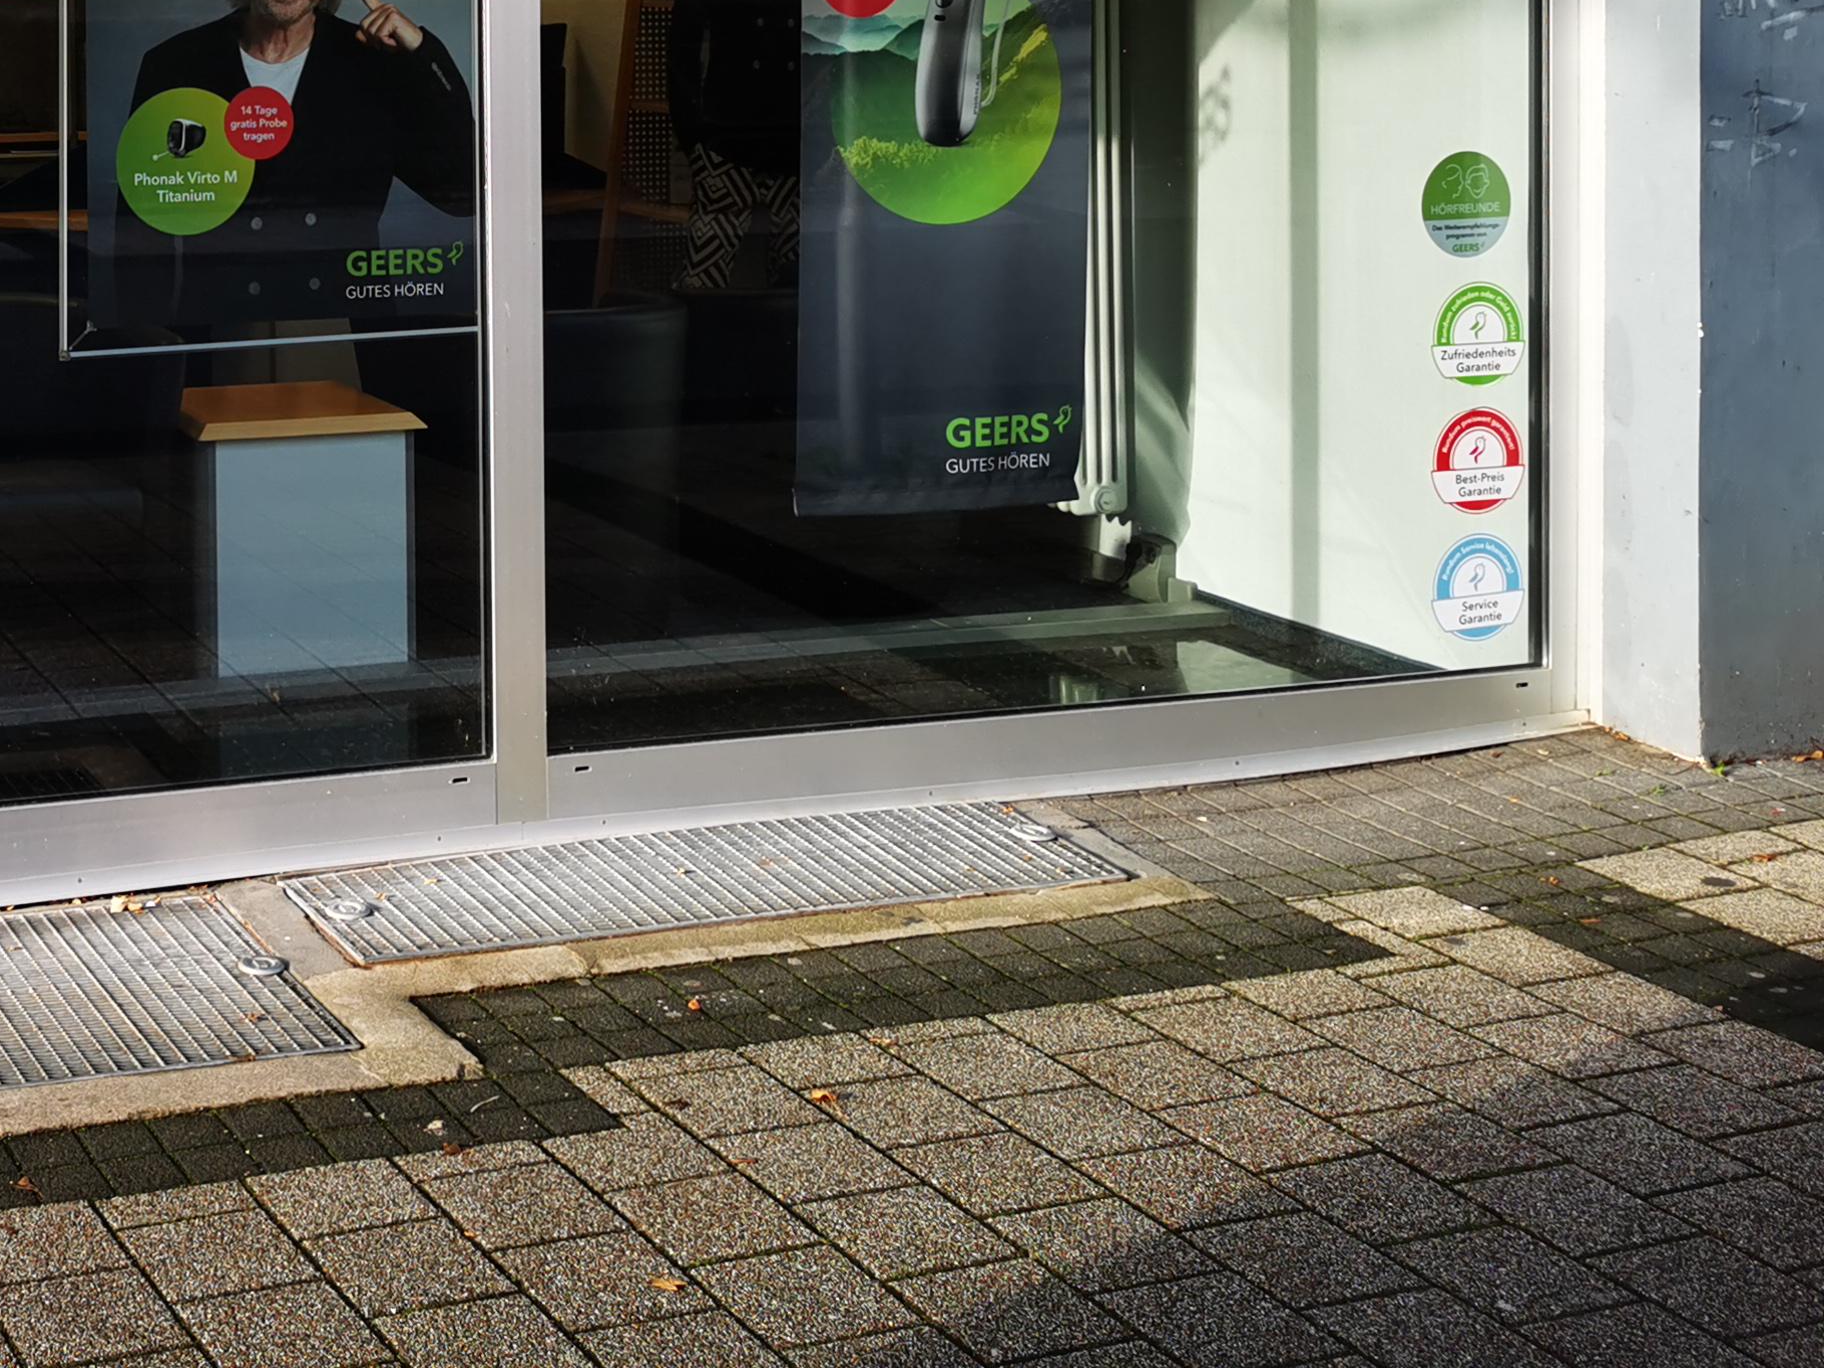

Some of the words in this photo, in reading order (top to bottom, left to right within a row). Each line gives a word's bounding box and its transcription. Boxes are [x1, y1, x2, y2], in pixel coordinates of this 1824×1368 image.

[240, 106, 252, 114] 14
[254, 105, 278, 117] Tage
[230, 119, 257, 130] gratis
[259, 119, 288, 128] Probe
[243, 132, 275, 143] tragen
[134, 172, 184, 186] Phonak
[186, 171, 220, 184] Virto
[224, 171, 238, 183] M
[156, 189, 215, 203] Titanium
[1431, 201, 1501, 215] HÖRFREUNDE
[1452, 243, 1480, 253] GEERS
[346, 248, 443, 277] GEERS
[346, 284, 391, 299] GUTES
[394, 281, 444, 297] HÖREN
[1441, 347, 1516, 360] Zufriedenheits
[1456, 361, 1501, 373] Garantie
[946, 413, 1050, 448] GEERS
[945, 457, 995, 474] GUTES
[998, 451, 1050, 470] HÖREN
[1456, 472, 1505, 484] Best-Preis
[1458, 486, 1502, 497] Garantie
[1462, 599, 1499, 612] Service
[1459, 612, 1502, 625] Garantie
